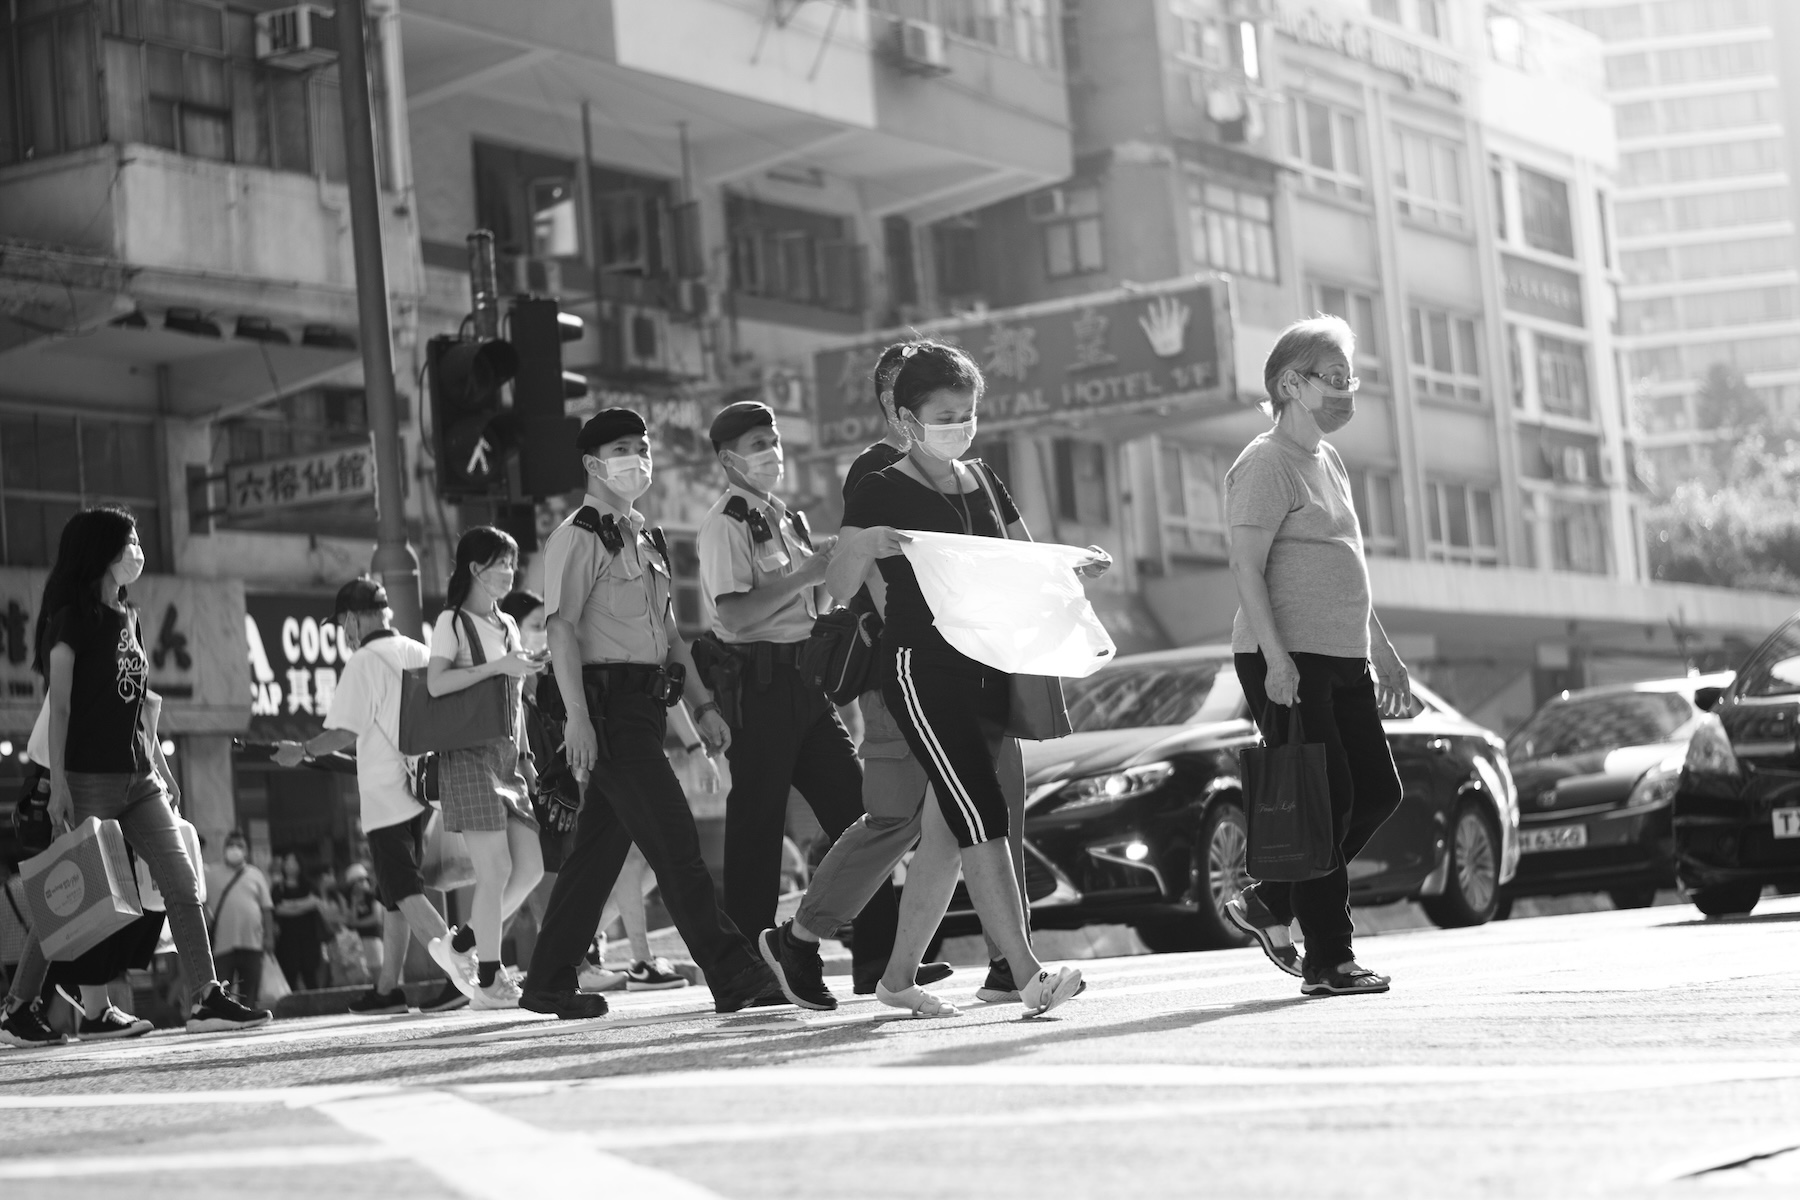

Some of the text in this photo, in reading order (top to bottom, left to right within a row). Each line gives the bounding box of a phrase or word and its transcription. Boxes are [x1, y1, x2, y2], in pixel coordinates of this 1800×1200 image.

[978, 388, 1050, 417] ITAL
[1060, 371, 1163, 405] HOTEL
[116, 656, 146, 681] goa
[1778, 812, 1800, 834] T
